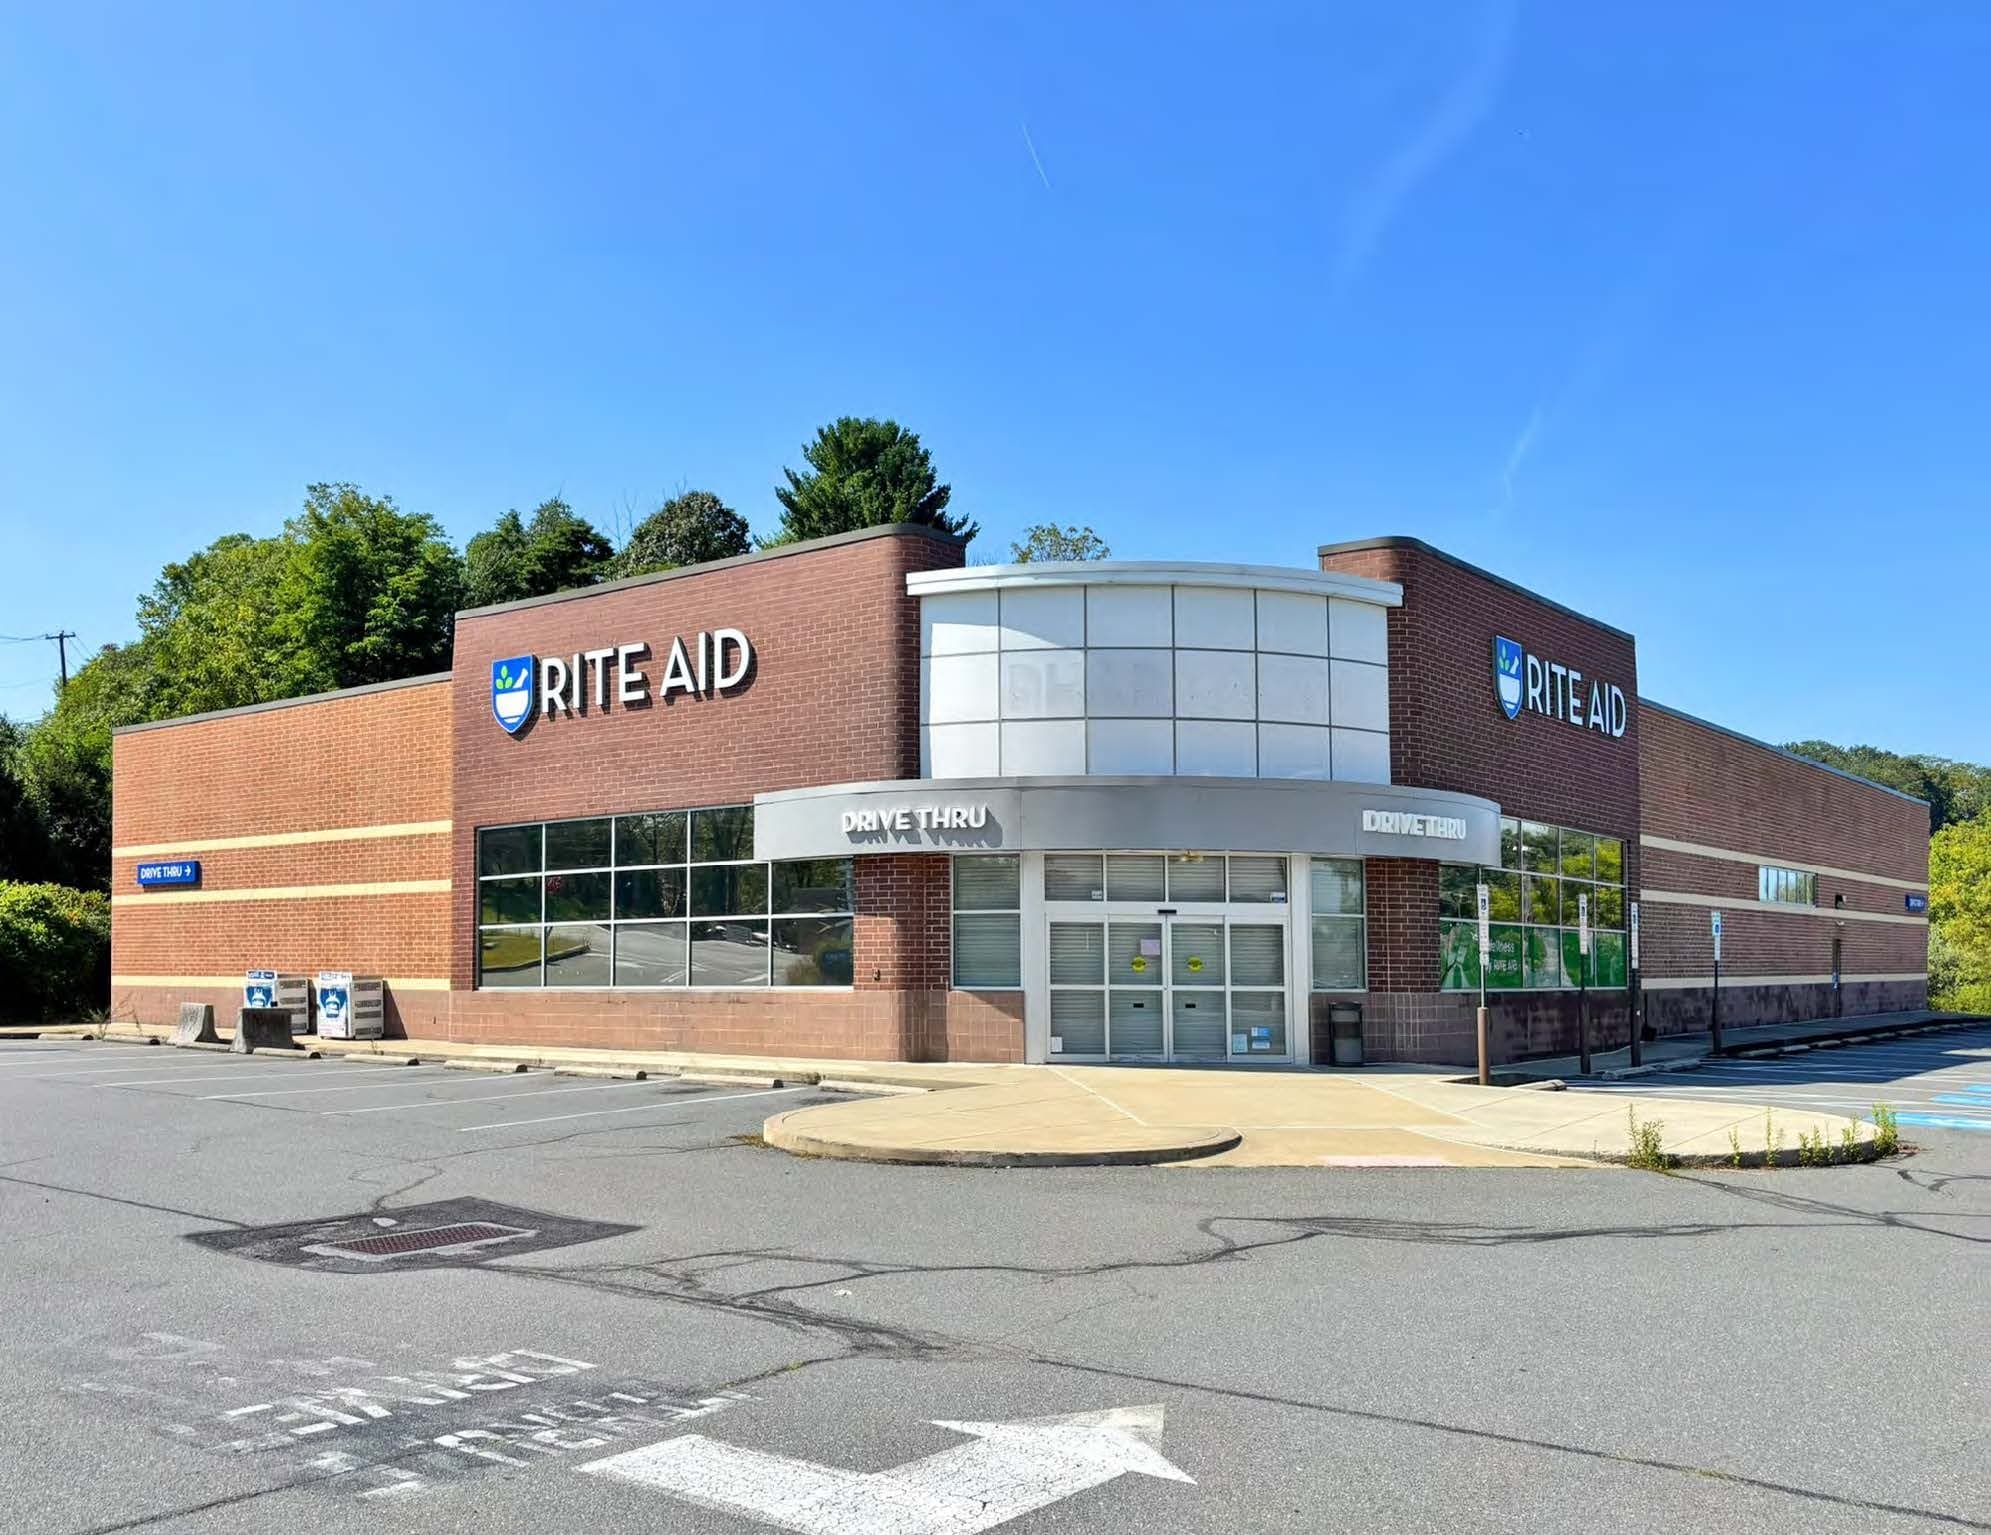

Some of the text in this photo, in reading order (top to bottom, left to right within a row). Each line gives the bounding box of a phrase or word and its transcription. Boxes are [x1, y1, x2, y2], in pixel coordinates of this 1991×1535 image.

[541, 628, 751, 713] RITE AID
[1526, 654, 1627, 738] RITE AID
[841, 803, 988, 833] DRIVE THRU
[1362, 809, 1466, 839] DRIVE THRU
[140, 865, 183, 879] DRIVE THRU
